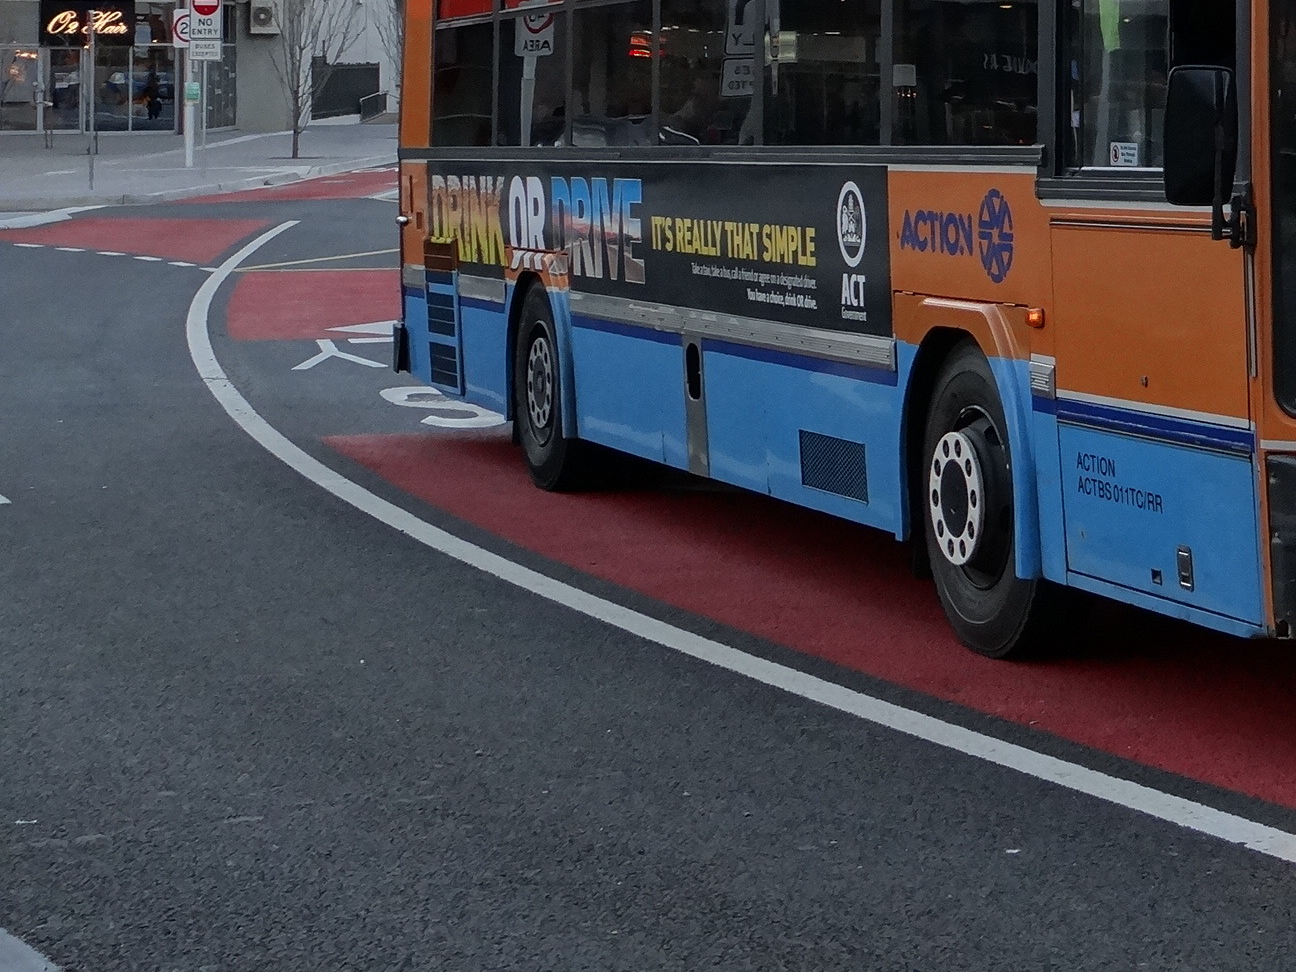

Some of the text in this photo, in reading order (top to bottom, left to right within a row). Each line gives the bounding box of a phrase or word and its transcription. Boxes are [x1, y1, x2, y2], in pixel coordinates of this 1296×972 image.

[81, 10, 128, 34] Hair
[180, 22, 188, 34] 2
[198, 18, 213, 26] NO
[432, 175, 646, 284] DRINK OR DRIVE
[651, 216, 816, 267] IT'S REALLY THAT SIMPLE
[901, 209, 973, 256] ACTION
[841, 273, 866, 307] ACT
[1077, 452, 1116, 477] ACTION
